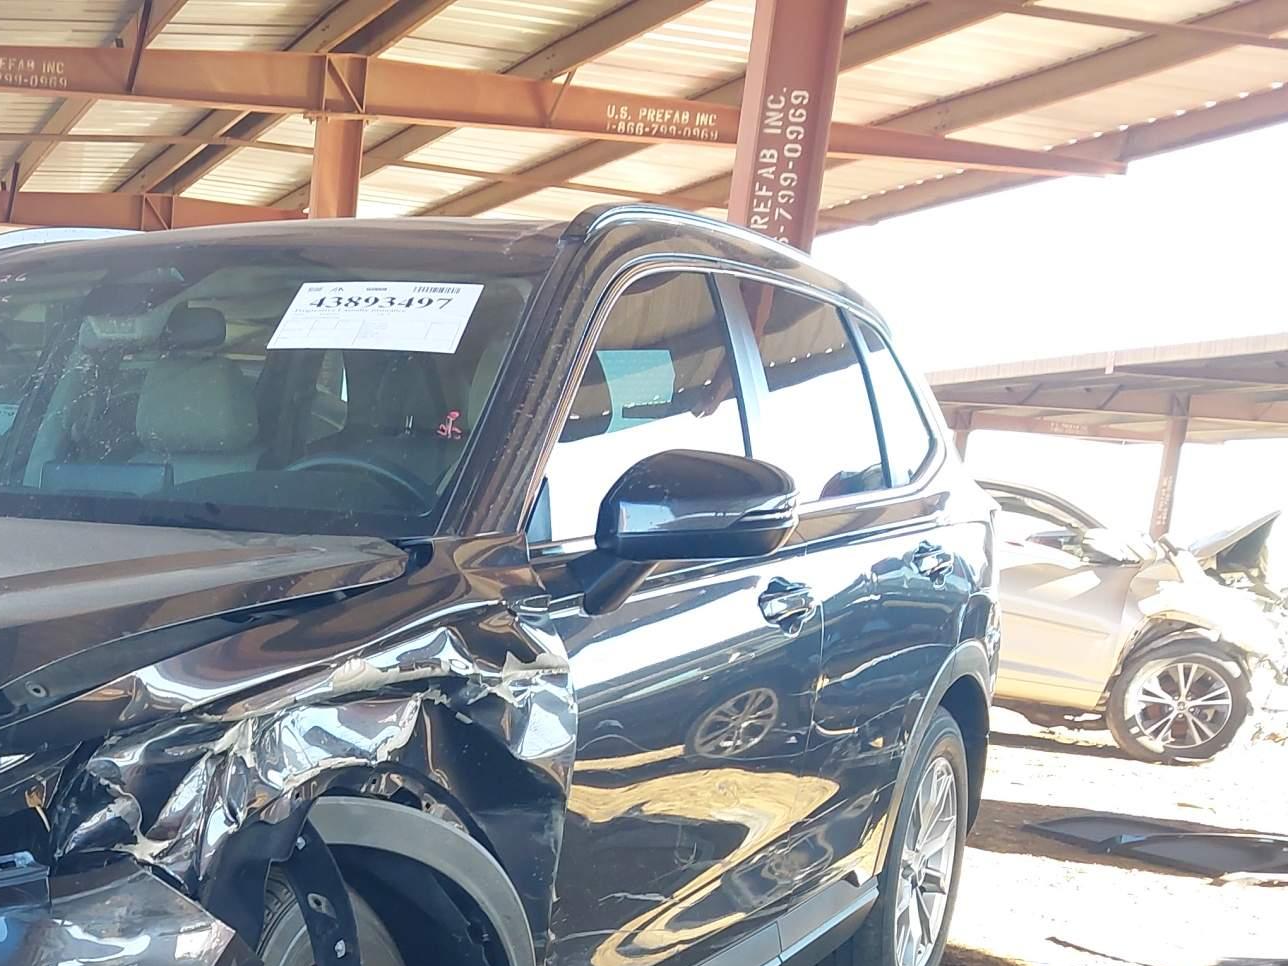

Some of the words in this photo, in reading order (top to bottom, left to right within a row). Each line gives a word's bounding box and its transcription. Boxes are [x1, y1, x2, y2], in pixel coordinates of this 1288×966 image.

[42, 61, 65, 74] INC
[606, 104, 631, 120] U.S.
[639, 107, 690, 125] PREFAB
[695, 112, 717, 127] INC
[763, 87, 787, 134] INC.
[750, 148, 779, 230] REFAB
[309, 296, 454, 309] 43893497
